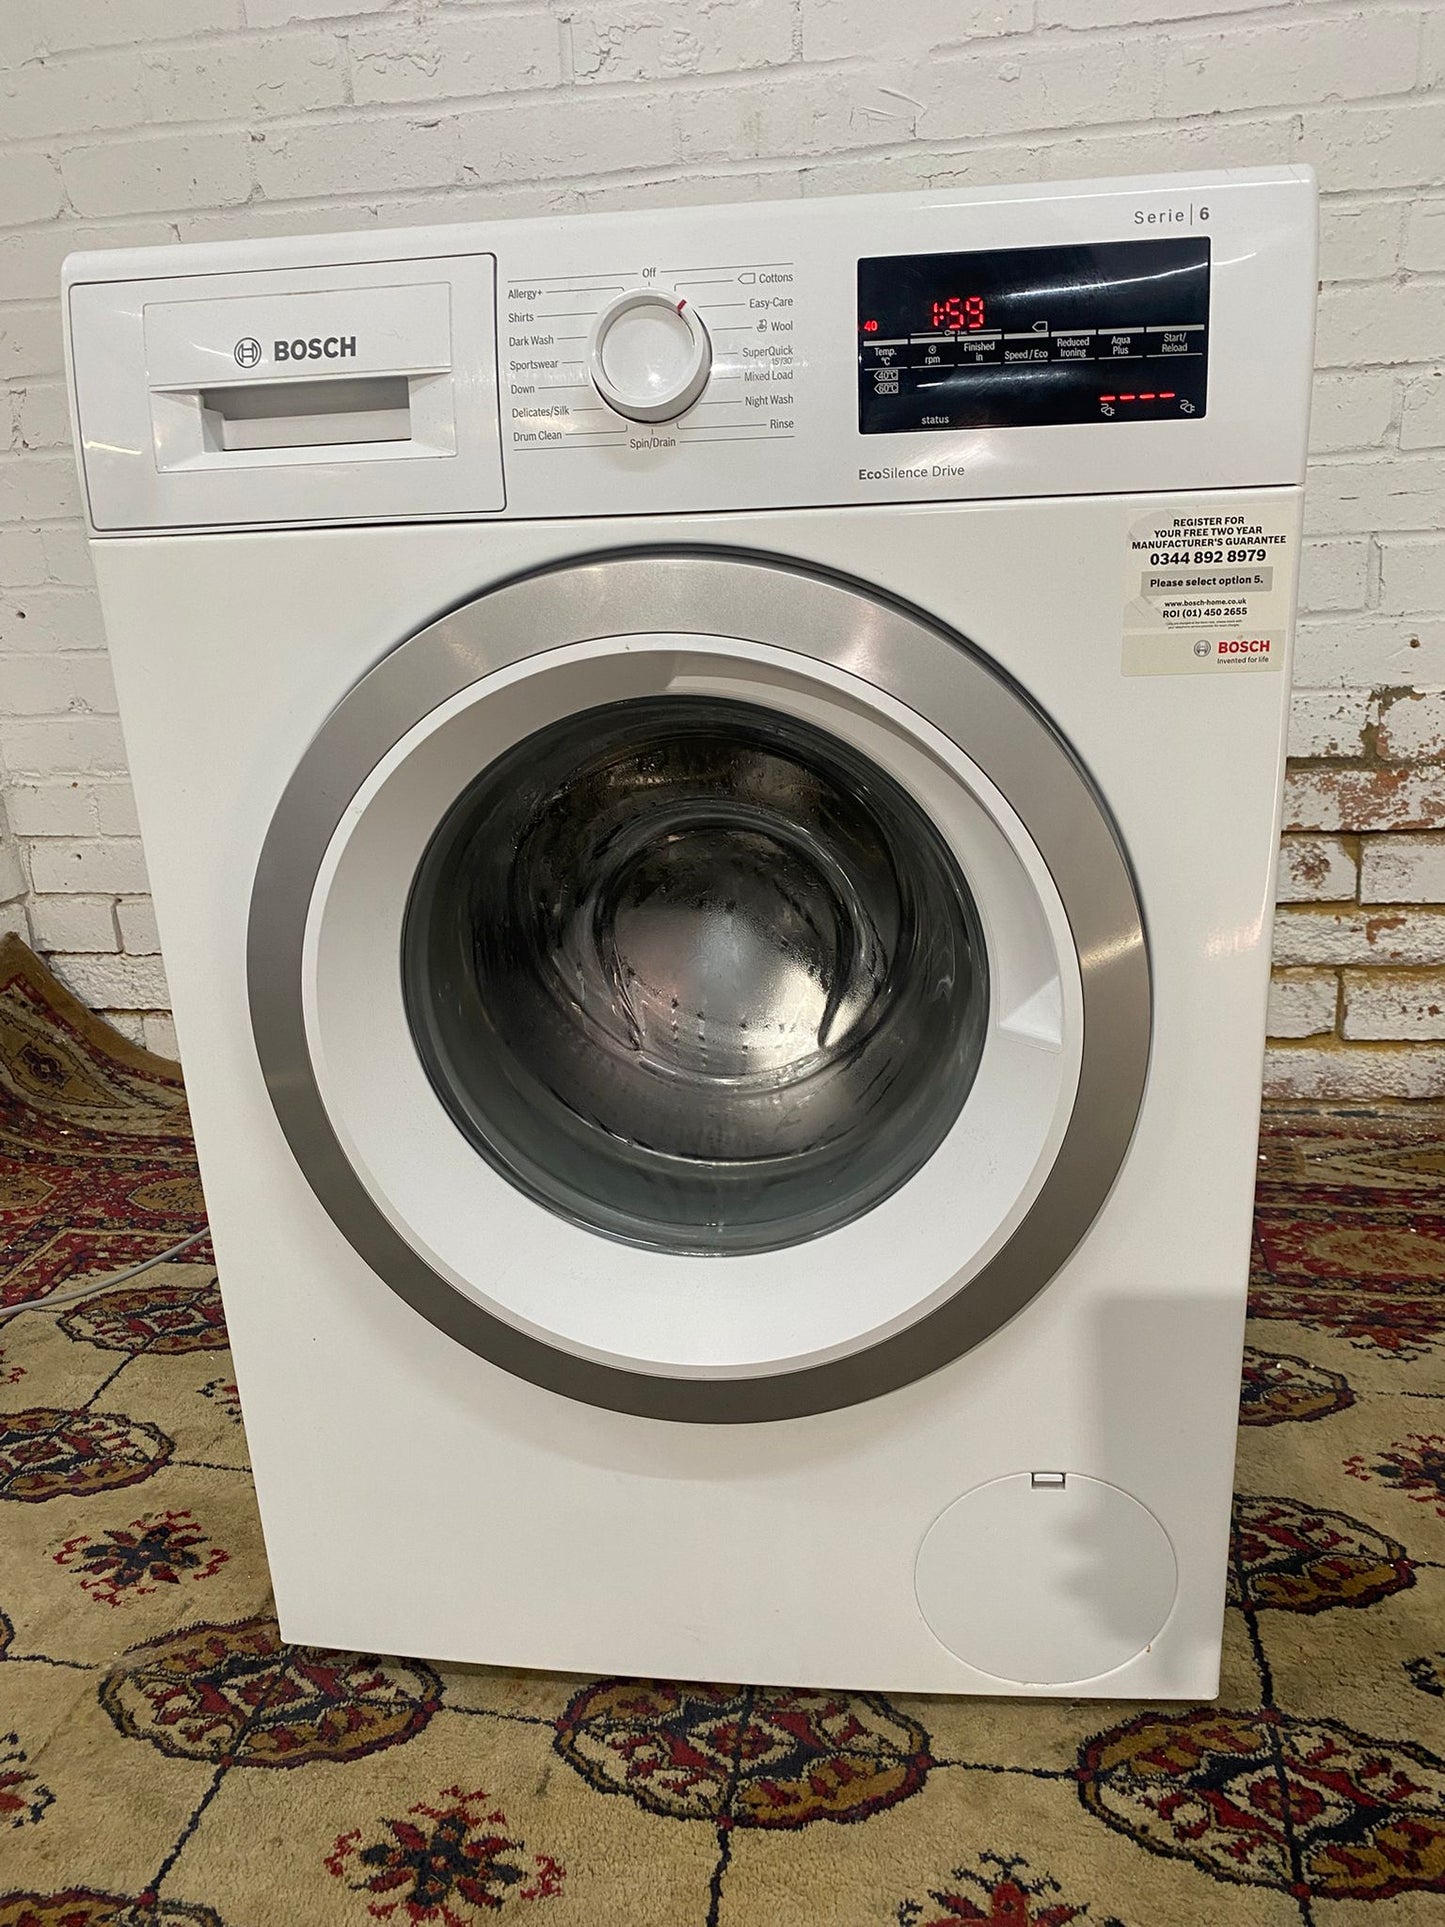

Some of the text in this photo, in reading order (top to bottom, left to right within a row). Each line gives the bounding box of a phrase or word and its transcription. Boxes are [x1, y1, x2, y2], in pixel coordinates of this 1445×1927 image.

[642, 267, 657, 278] Off
[759, 272, 793, 283] Cottons
[508, 289, 543, 300] Allergy+
[749, 297, 793, 310] Easy-Care
[508, 312, 534, 323] Shirts
[933, 297, 984, 329] 1:59
[771, 321, 793, 331] Wool
[864, 320, 879, 332] 40
[509, 334, 554, 346] Dark Wash
[1057, 337, 1090, 347] Reduced
[1111, 335, 1131, 346] Aqua
[1164, 332, 1187, 342] Start/
[274, 336, 356, 361] BOSCH
[743, 345, 793, 359] SuperQuick
[874, 347, 897, 356] Temp.
[963, 341, 995, 352] Finished
[1113, 345, 1129, 355] Plus
[1162, 342, 1188, 353] Reload
[976, 352, 983, 361] in
[1060, 347, 1087, 358] Ironing
[510, 359, 558, 371] Sportswear
[925, 355, 941, 365] rpm
[745, 369, 793, 381] Mixed Load
[511, 384, 535, 394] Down
[745, 394, 794, 408] Night Wash
[512, 406, 570, 418] Delicates/Silk
[770, 419, 794, 429] Rinse
[921, 416, 950, 425] status
[513, 430, 562, 442] Drum Clean
[630, 437, 676, 449] Spin/Drain
[859, 465, 965, 480] EcoSilence Drive
[1173, 516, 1245, 527] REGISTER FOR
[1154, 526, 1262, 538] YOUR FREE TWO YEAR
[1132, 535, 1287, 550] MANUFACTURER'S GUARANTEE
[1150, 549, 1267, 566] 0344 892 8979
[1150, 575, 1264, 588] Please select option 5.
[1164, 598, 1247, 607] www.bosch-home.co.uk
[1162, 607, 1248, 619] ROI (01) 450 2655
[1218, 640, 1271, 654] BOSCH
[1247, 656, 1257, 664] for
